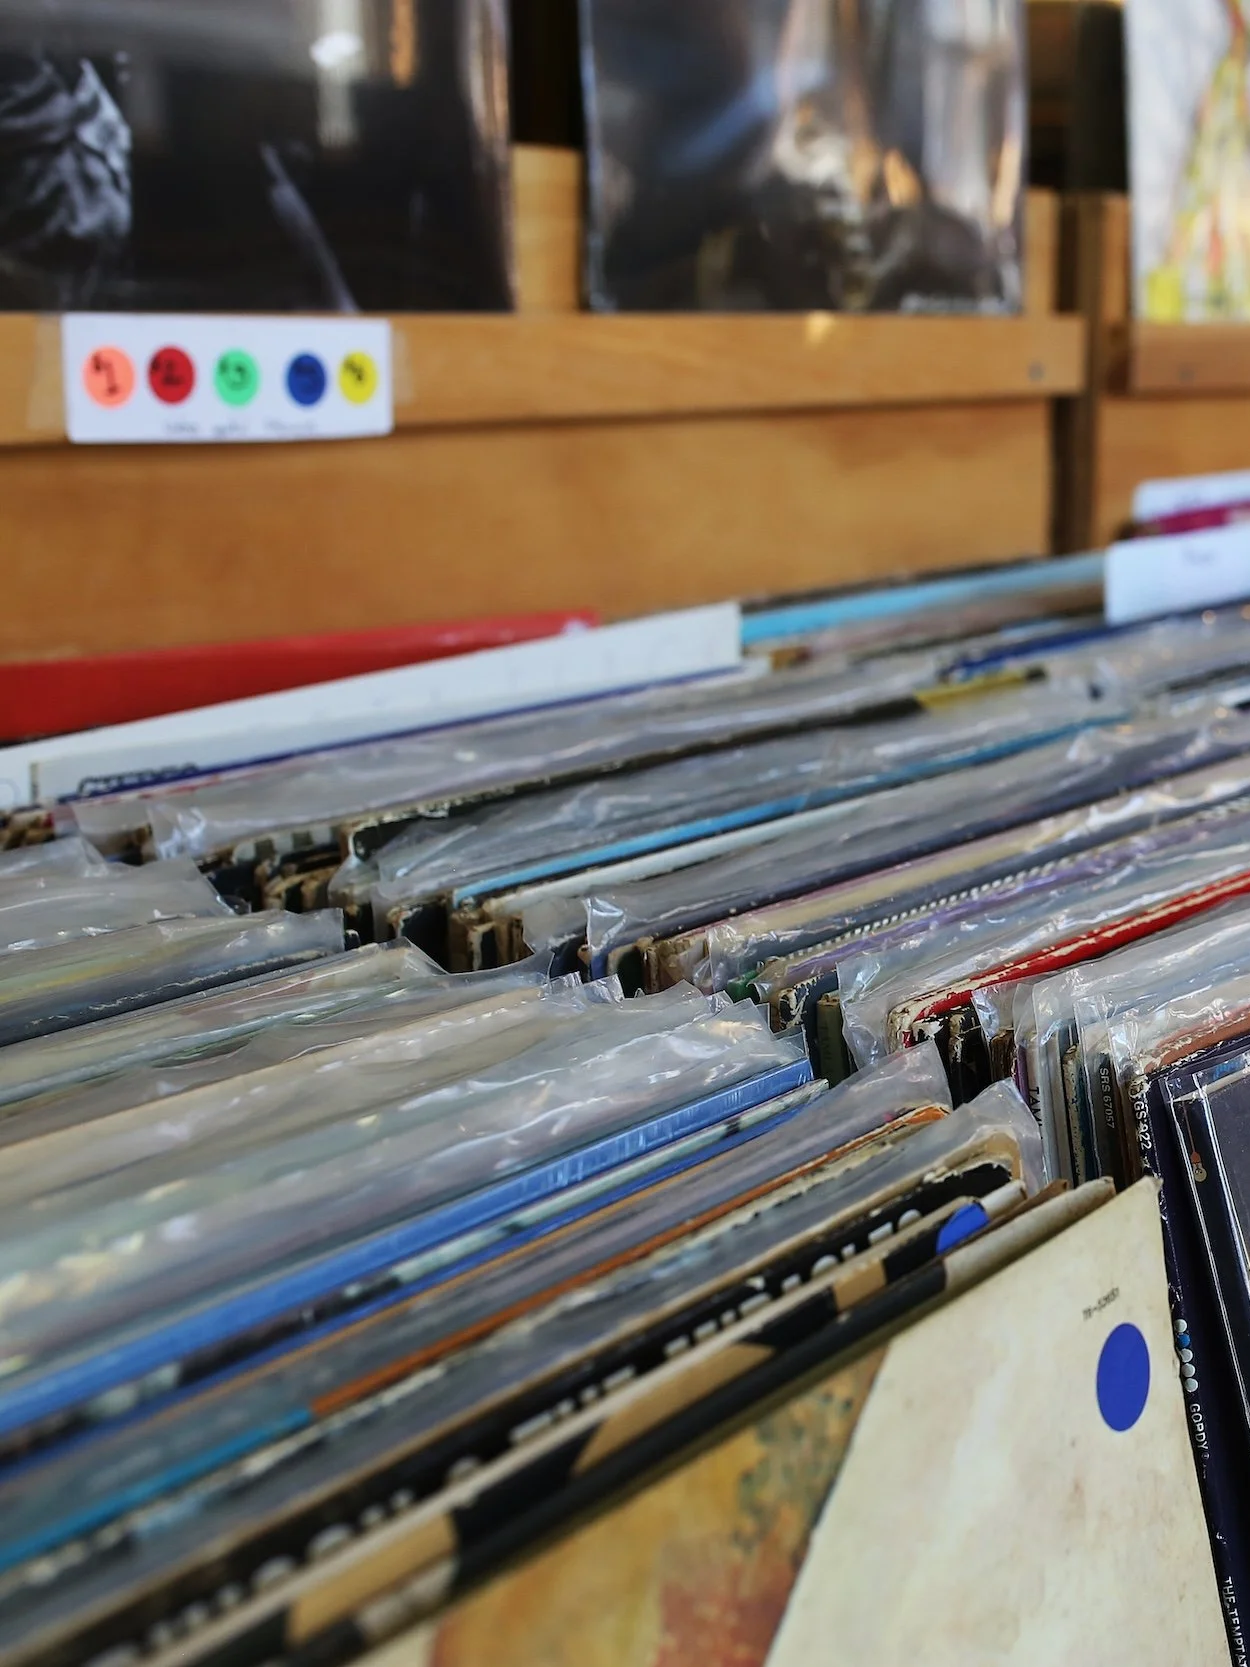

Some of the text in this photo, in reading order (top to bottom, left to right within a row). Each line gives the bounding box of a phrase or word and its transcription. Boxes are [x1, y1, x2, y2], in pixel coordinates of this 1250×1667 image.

[1099, 1067, 1115, 1129] SRS 67057
[1224, 1576, 1236, 1604] THE
